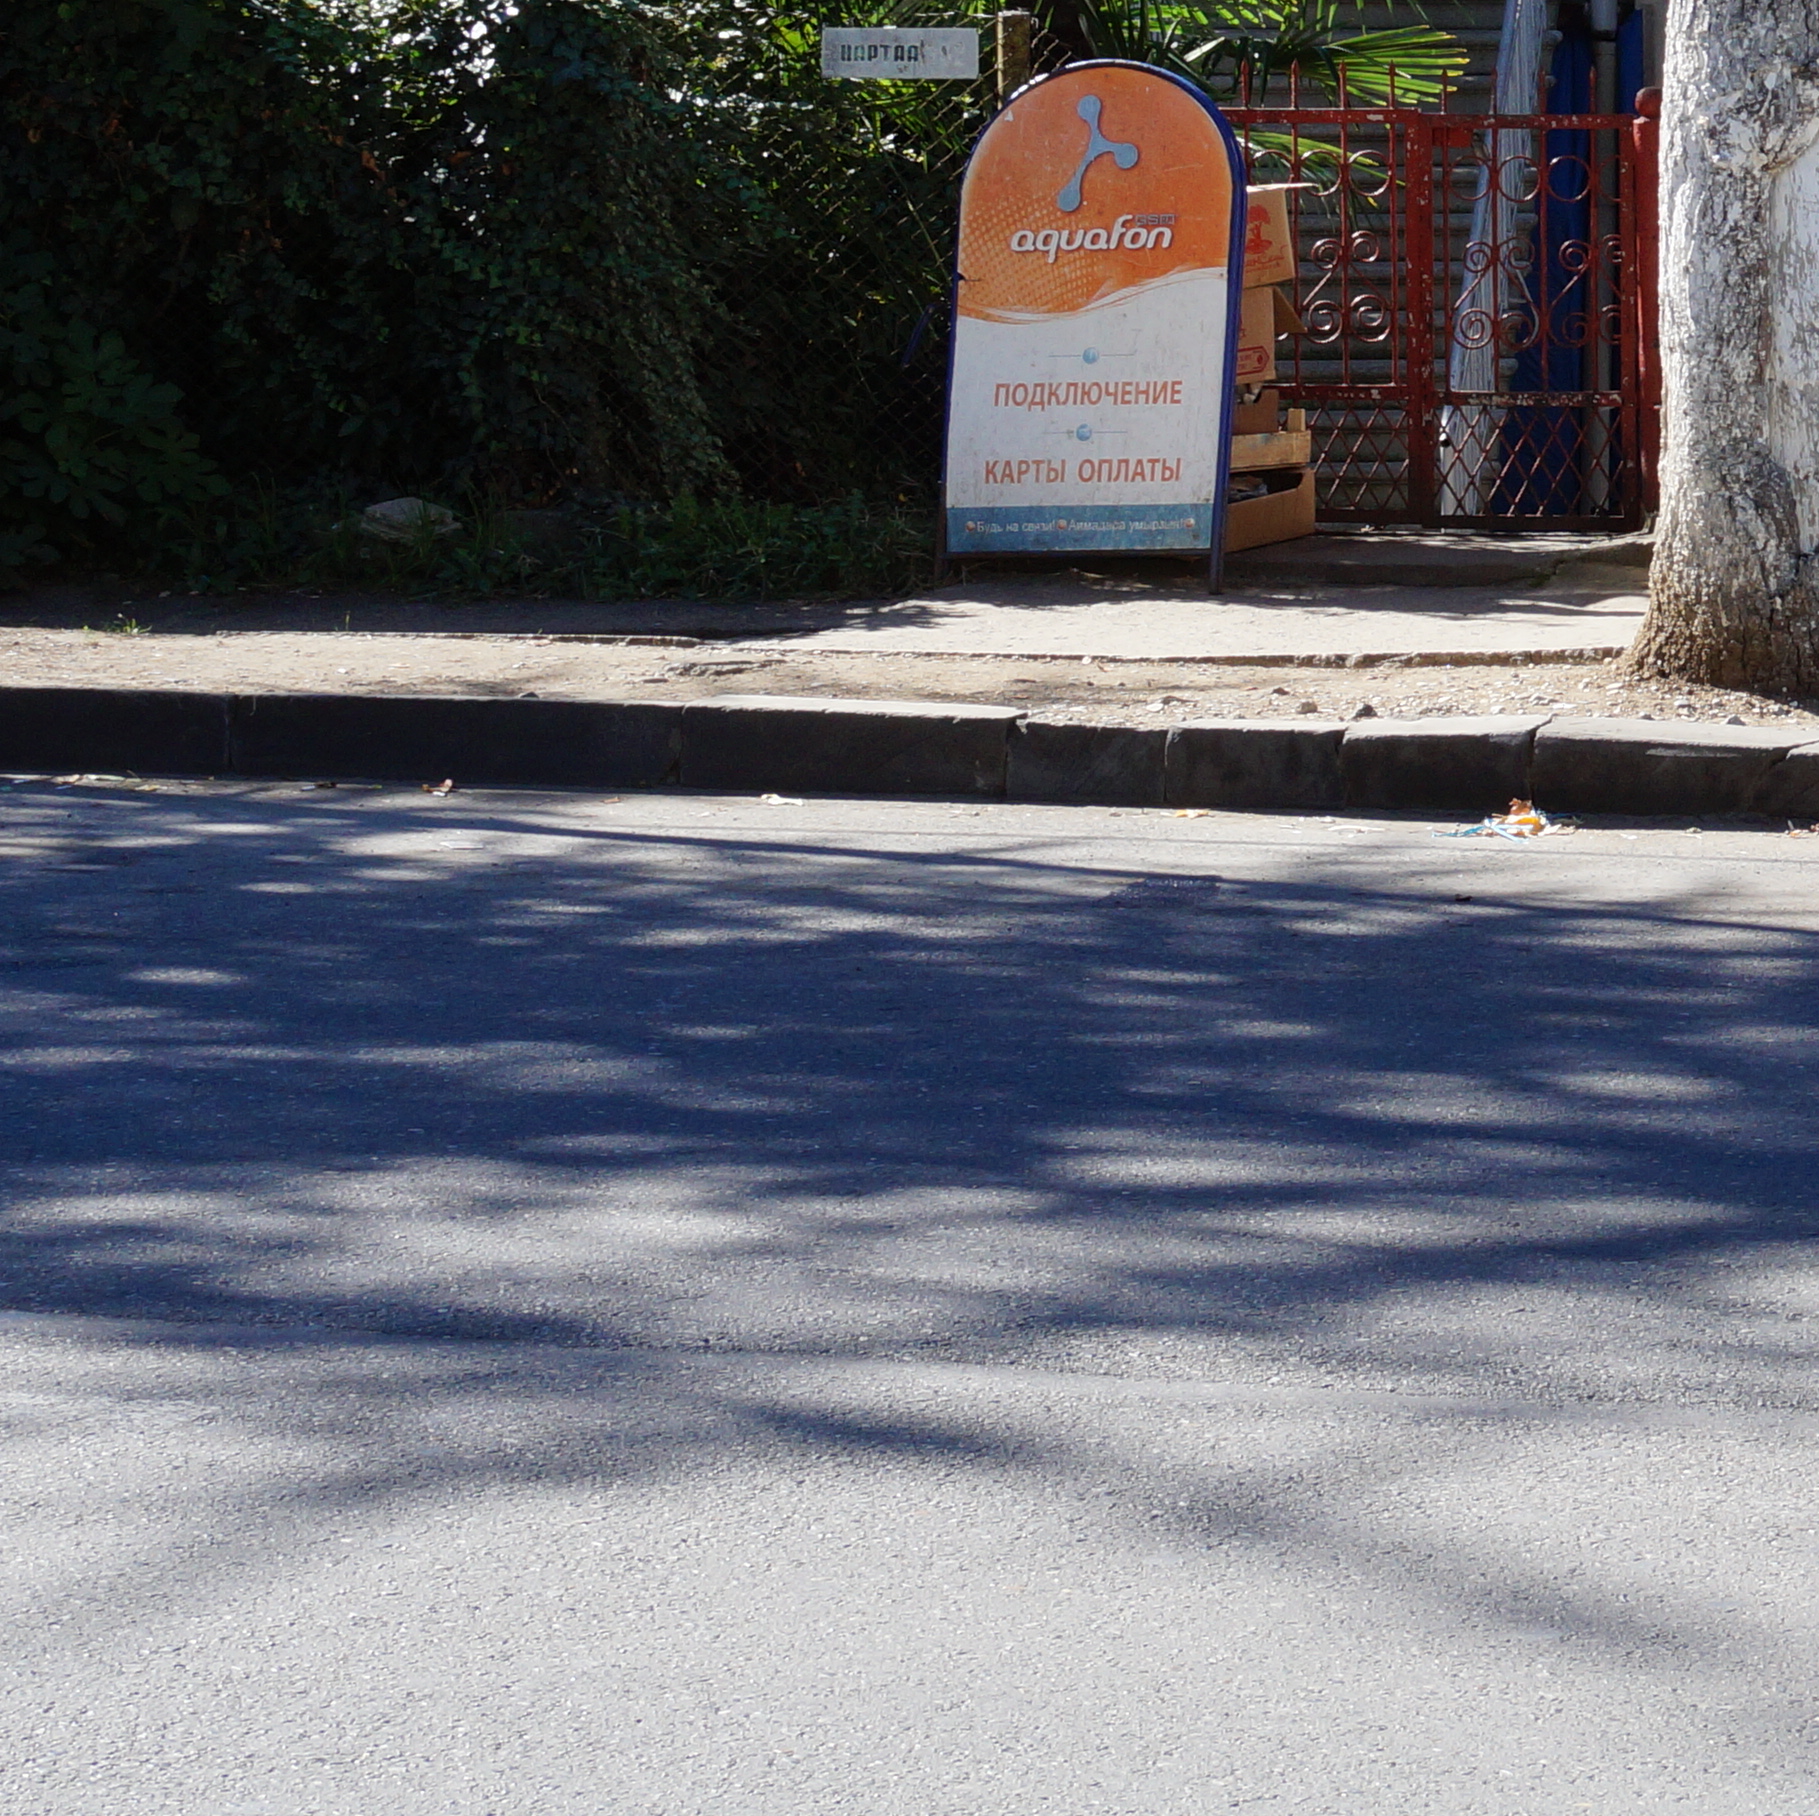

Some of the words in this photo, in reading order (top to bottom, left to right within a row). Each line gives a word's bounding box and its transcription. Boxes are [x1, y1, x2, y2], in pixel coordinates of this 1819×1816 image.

[1010, 214, 1173, 263] aquafon
[994, 380, 1183, 411] ПОДКЛЮЧЕНИЕ
[984, 459, 1067, 484] КАРТЫ
[1077, 457, 1183, 483] ОПЛАТЫ
